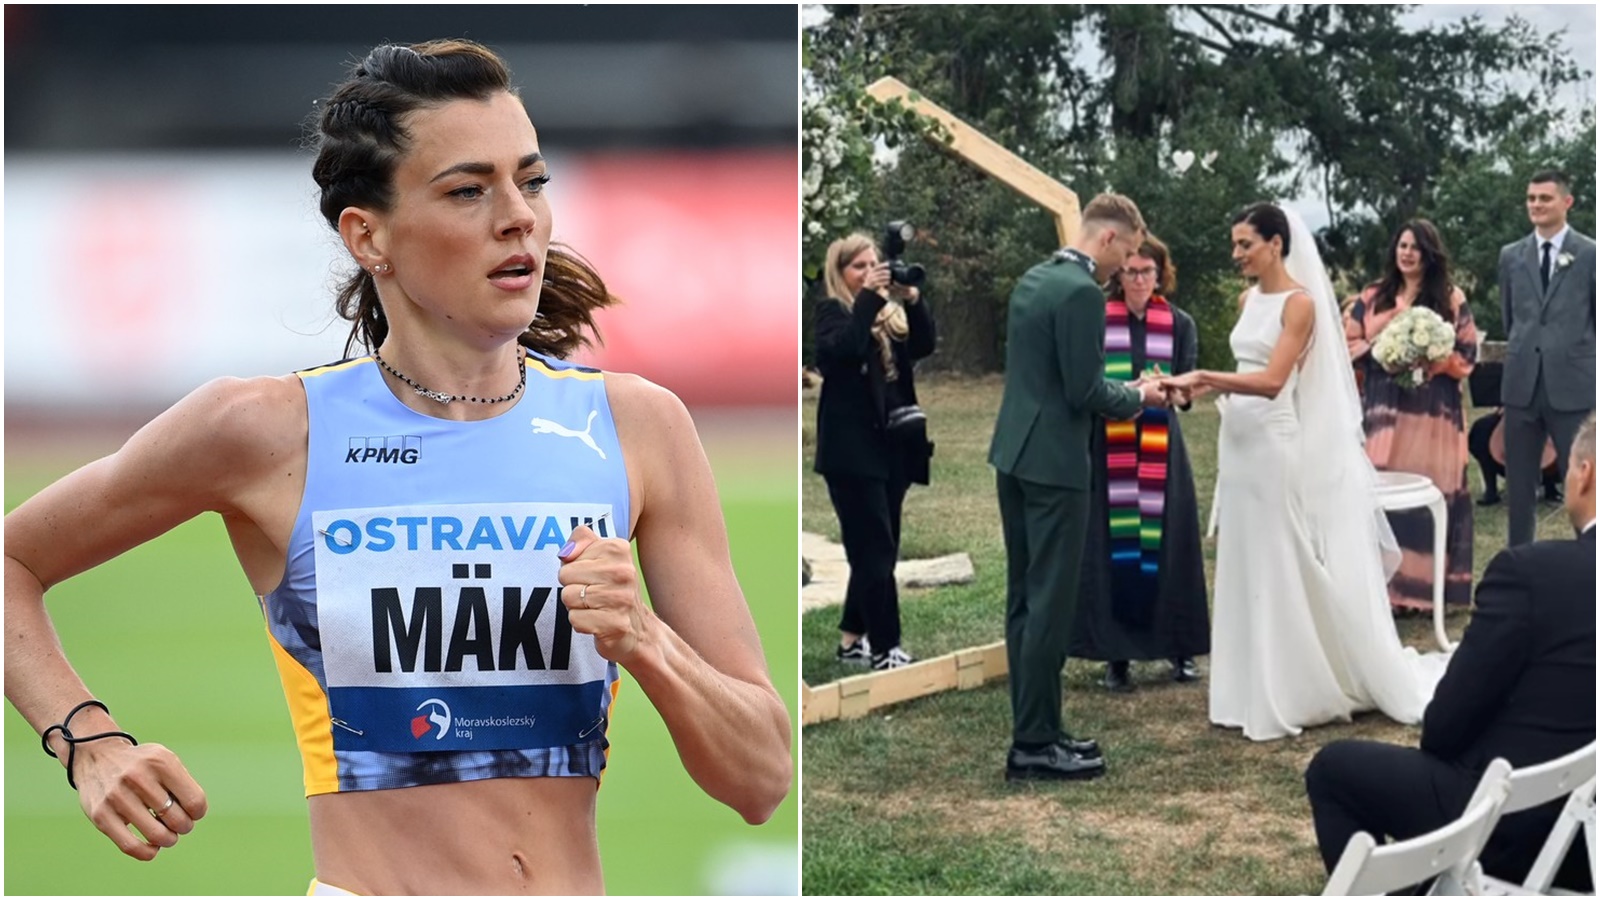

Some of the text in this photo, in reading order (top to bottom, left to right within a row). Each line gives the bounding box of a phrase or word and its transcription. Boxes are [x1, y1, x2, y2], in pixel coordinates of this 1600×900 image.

[345, 447, 419, 464] KPMG
[371, 563, 573, 673] MÄKI
[454, 715, 536, 728] Moravskoslezský
[455, 728, 473, 740] kraj
